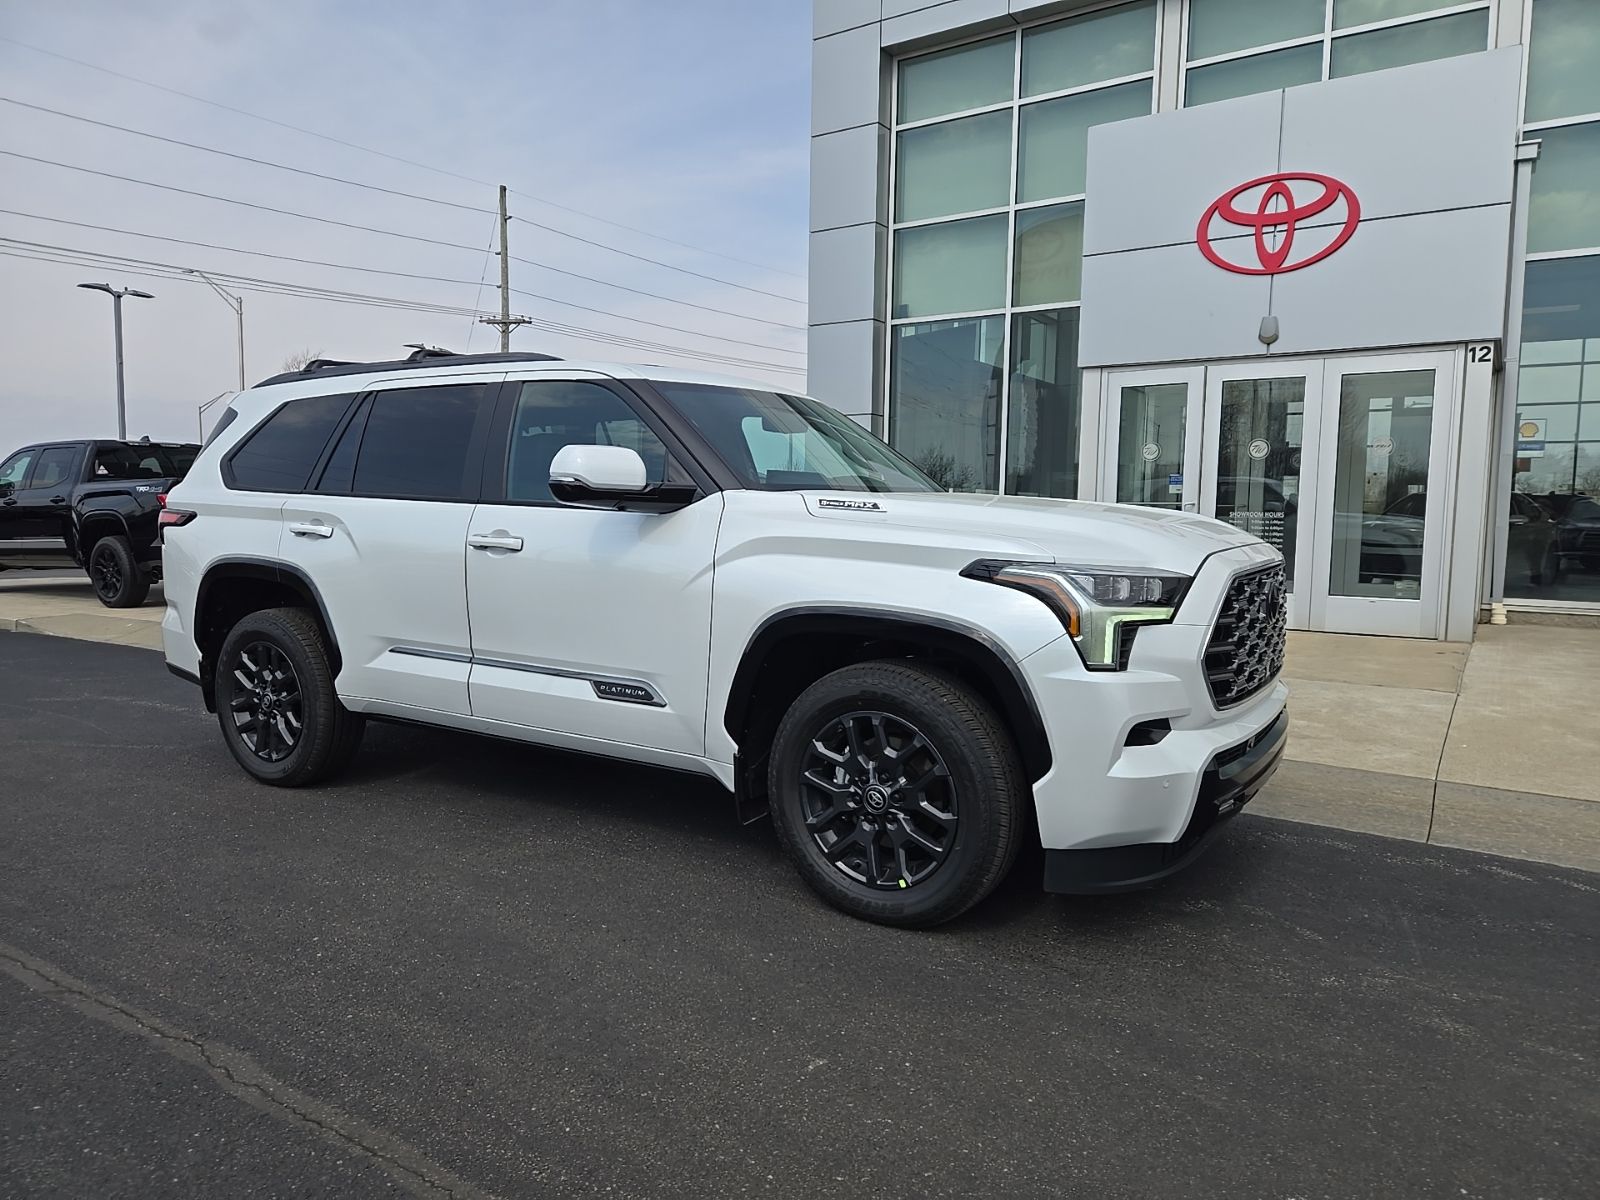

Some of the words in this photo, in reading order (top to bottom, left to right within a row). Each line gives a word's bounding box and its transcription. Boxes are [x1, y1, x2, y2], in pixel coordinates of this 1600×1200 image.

[1469, 346, 1491, 363] 12
[1229, 511, 1264, 519] SHOWROOM
[1264, 511, 1285, 519] HOURS
[600, 685, 646, 696] PLATINUM
